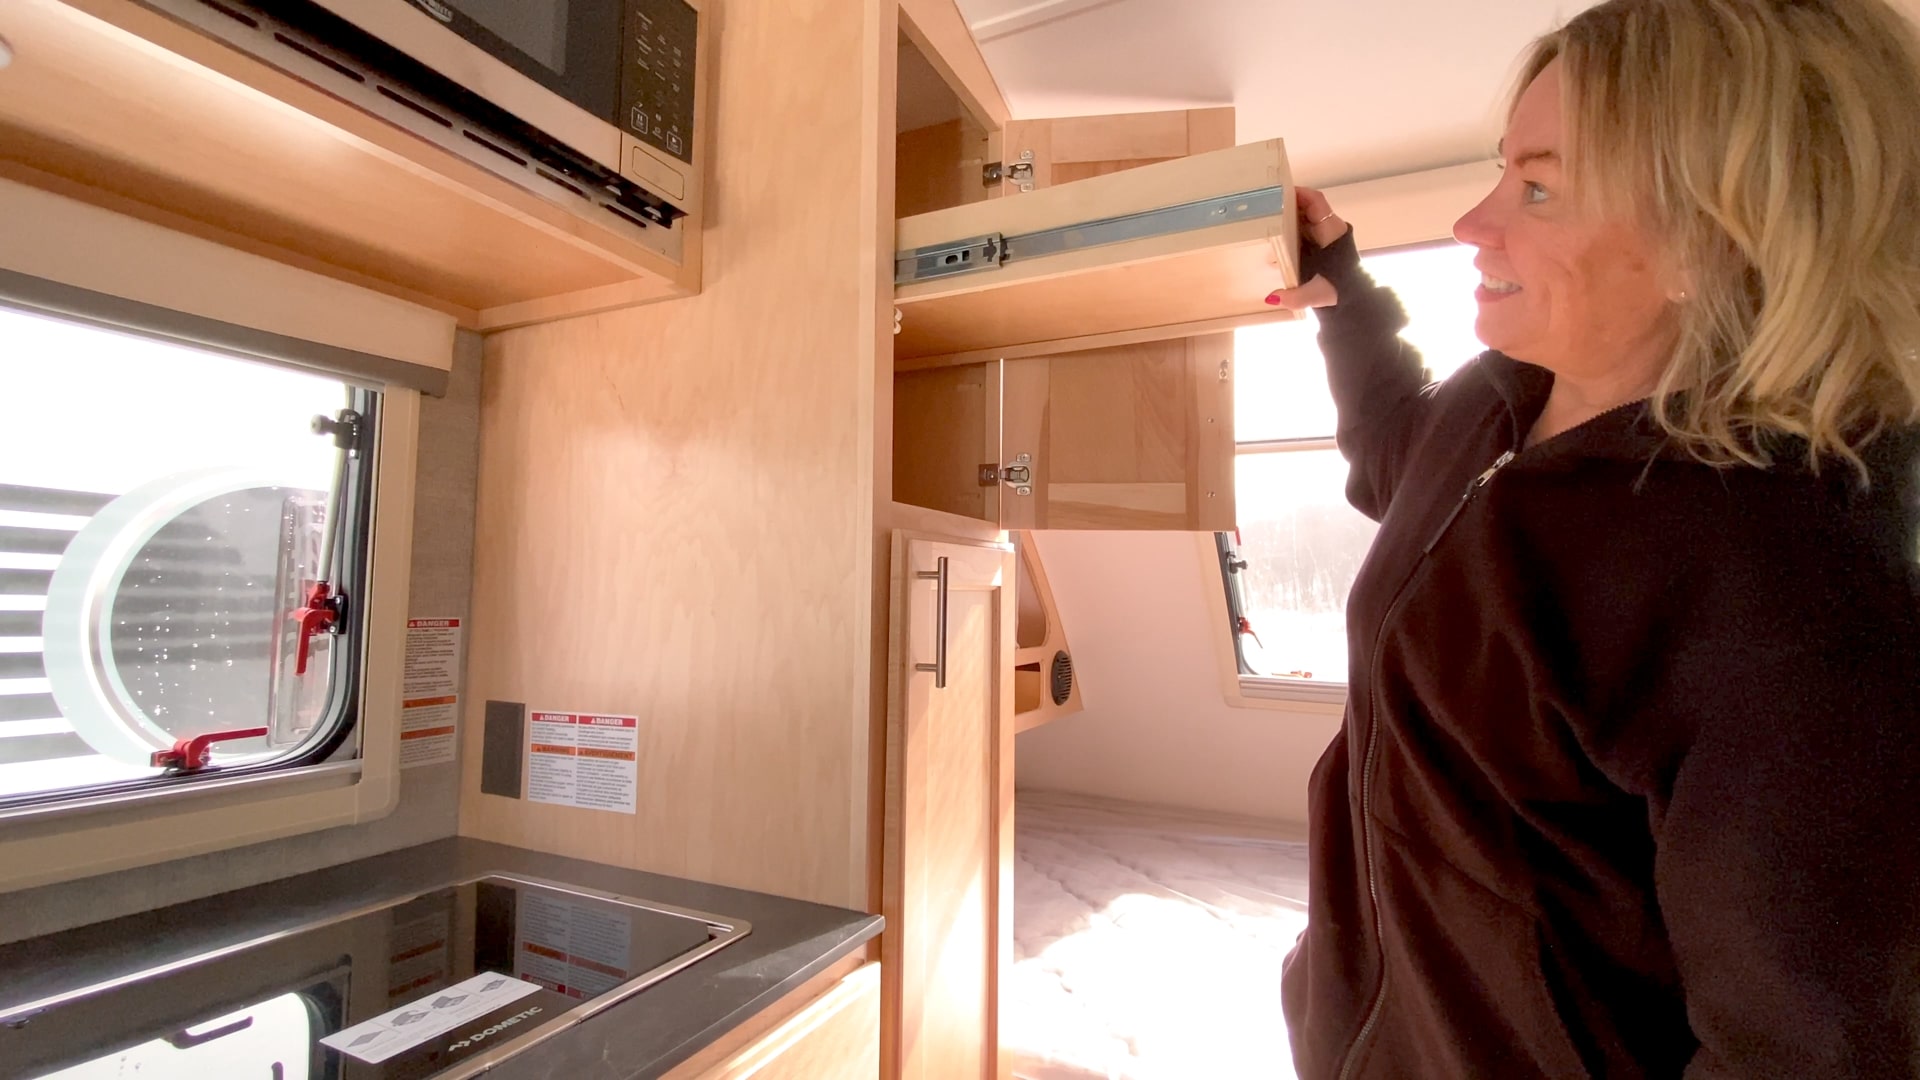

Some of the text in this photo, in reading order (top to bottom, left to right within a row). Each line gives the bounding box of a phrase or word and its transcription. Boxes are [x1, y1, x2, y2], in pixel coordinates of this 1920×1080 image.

[544, 714, 570, 722] DANGER
[596, 717, 623, 726] DANGER
[470, 1005, 544, 1043] DOMETIC
